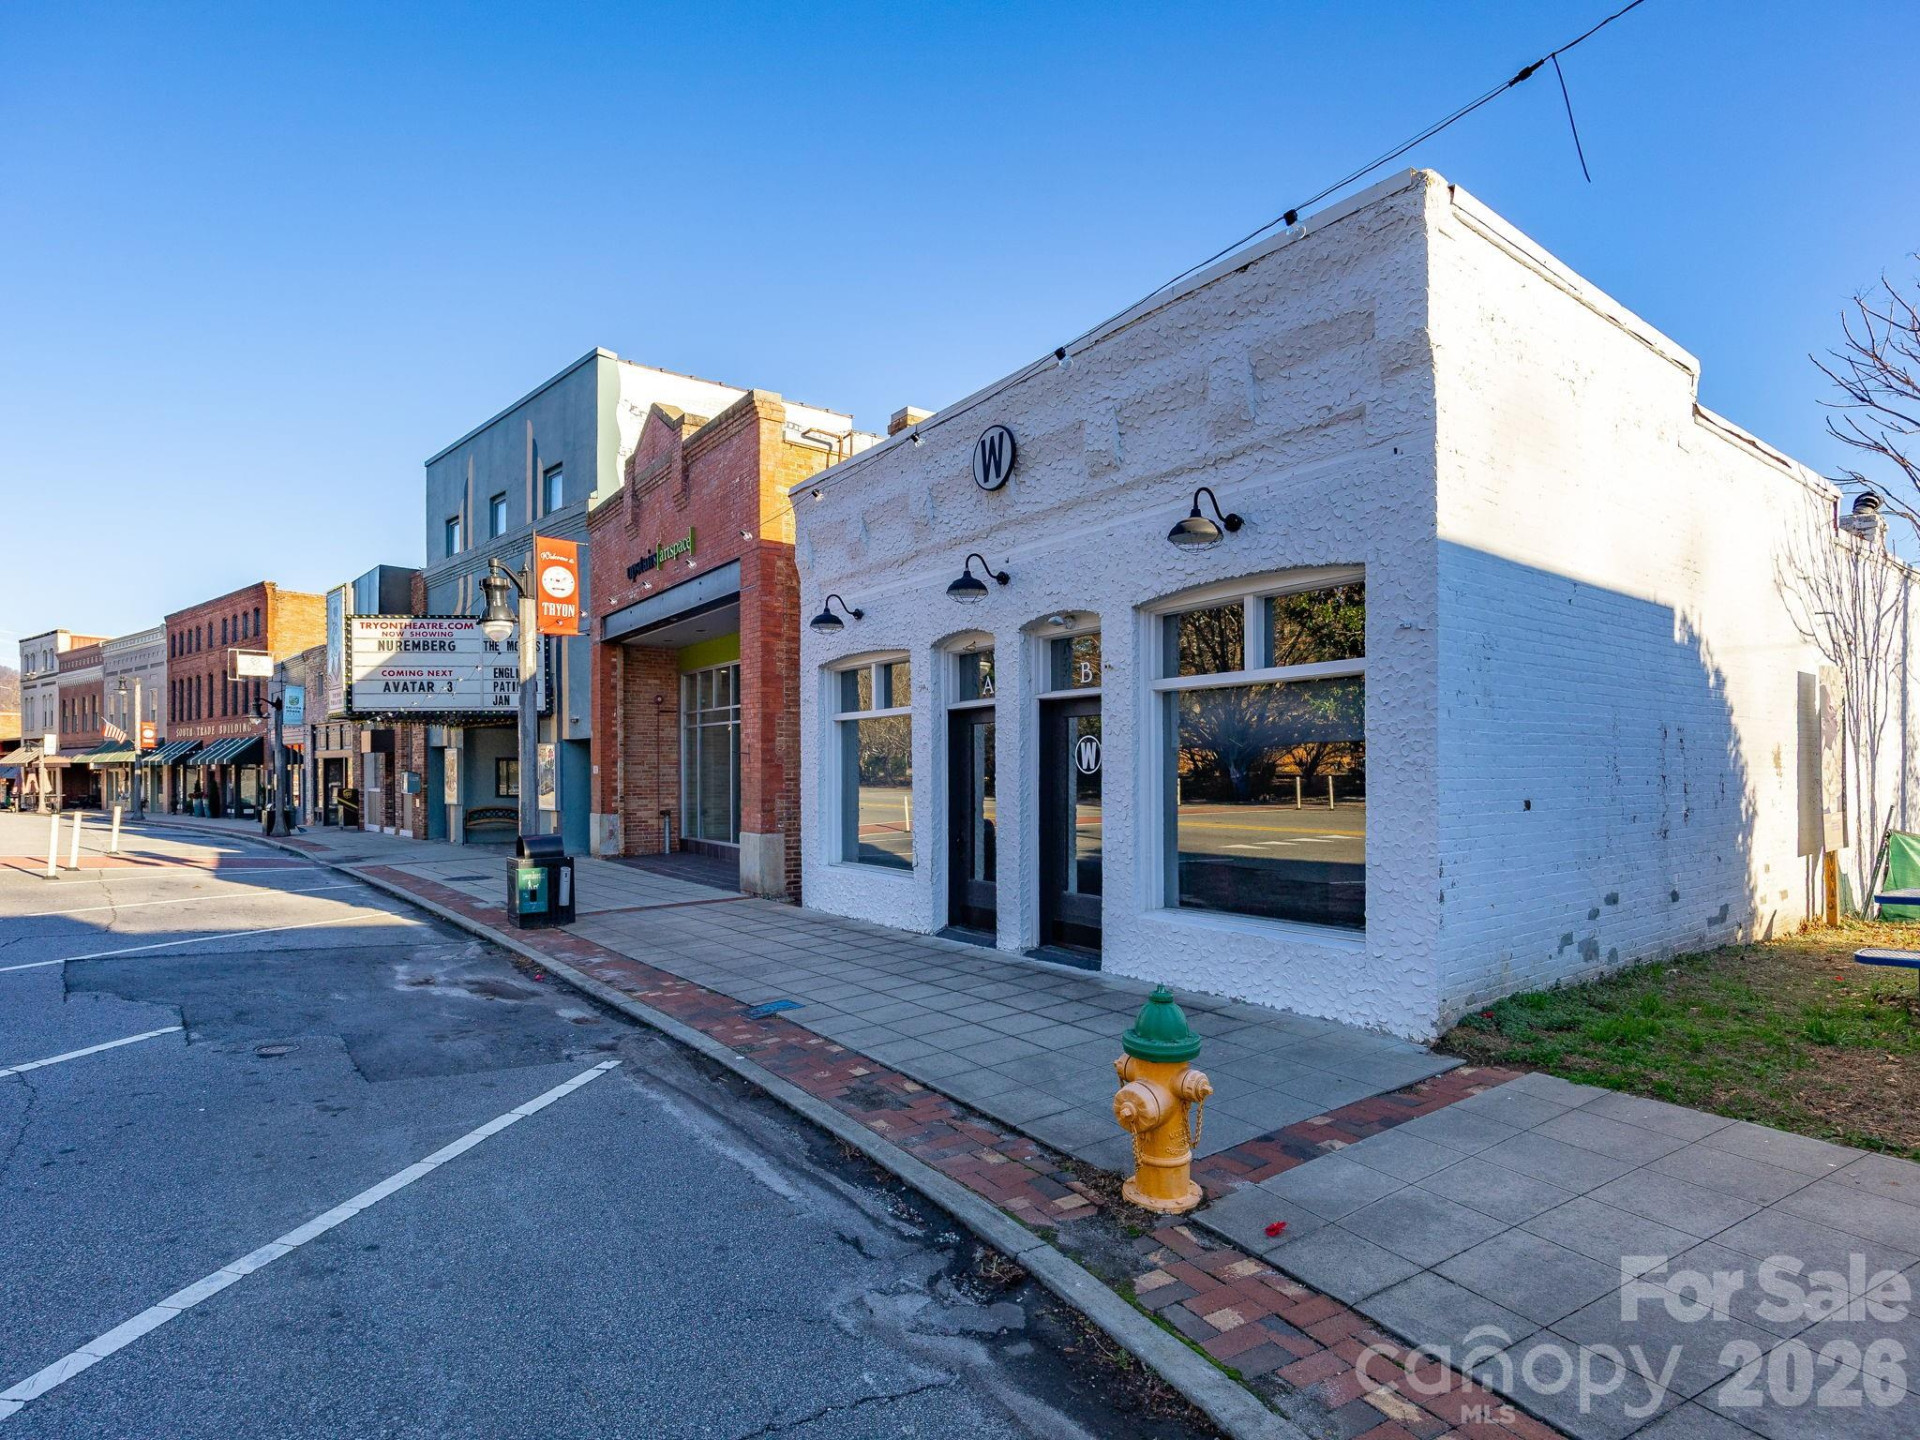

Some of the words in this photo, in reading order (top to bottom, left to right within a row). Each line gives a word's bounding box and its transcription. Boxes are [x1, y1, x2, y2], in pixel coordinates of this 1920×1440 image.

[981, 431, 1004, 483] W
[542, 602, 575, 617] TRYON
[360, 622, 474, 630] TRYONTHEATRE.COM
[378, 640, 456, 652] NUREMBERG
[483, 640, 500, 652] THE
[1080, 662, 1093, 684] B
[383, 682, 435, 692] AVATAR
[447, 681, 453, 692] 3
[982, 676, 994, 695] A
[493, 695, 510, 706] JAN
[176, 727, 193, 737] SOUTH
[197, 725, 215, 736] TRADE
[219, 722, 252, 735] BUILDING
[1081, 742, 1097, 770] W
